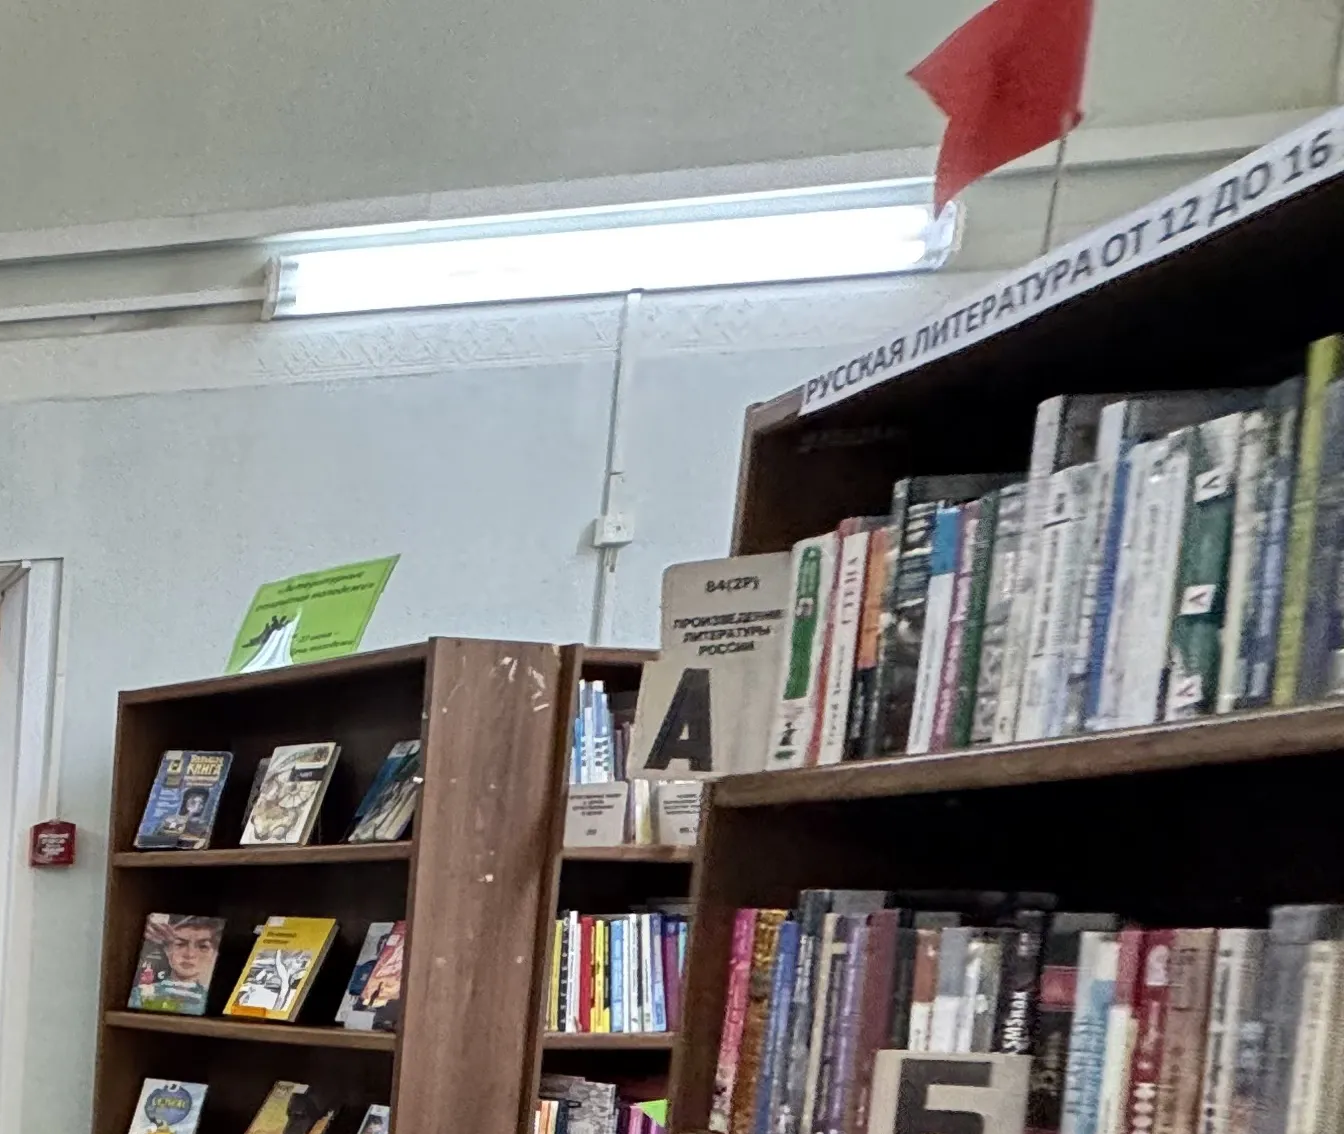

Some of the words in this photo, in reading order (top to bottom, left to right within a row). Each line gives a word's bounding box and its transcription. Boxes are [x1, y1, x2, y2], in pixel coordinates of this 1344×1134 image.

[805, 336, 906, 404] РУССКАЯ
[911, 248, 1093, 361] ЛИТЕРАТУРА
[1101, 219, 1150, 267] ОТ
[1158, 195, 1201, 243] 12
[1208, 161, 1274, 227] ДО
[1283, 129, 1332, 183] 16
[683, 625, 770, 643] ЛИТЕРАТУРЫ
[697, 640, 754, 656] РОССИИ
[643, 668, 713, 771] А
